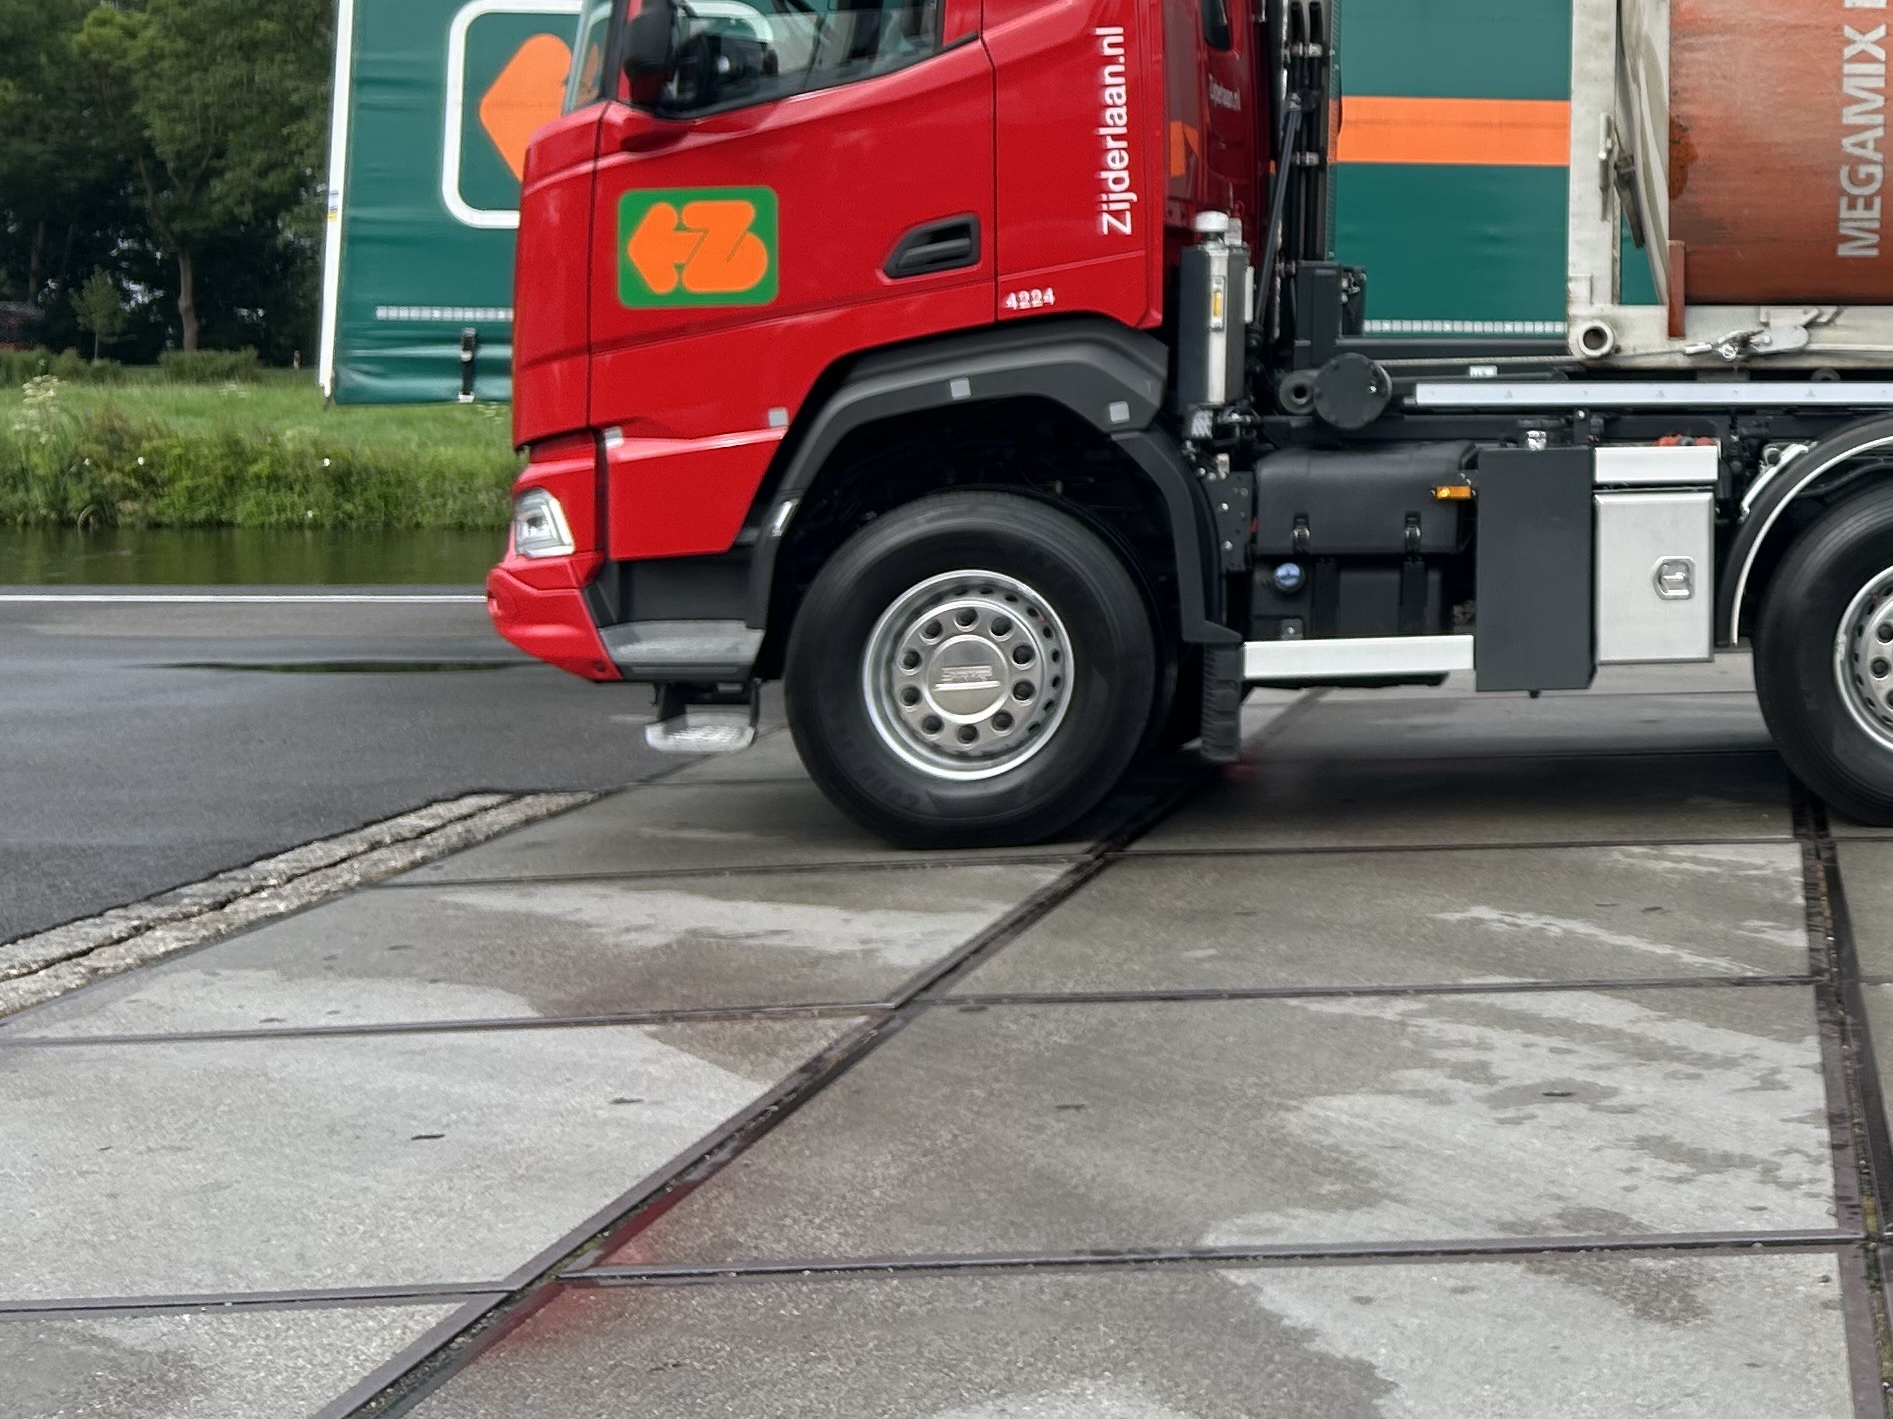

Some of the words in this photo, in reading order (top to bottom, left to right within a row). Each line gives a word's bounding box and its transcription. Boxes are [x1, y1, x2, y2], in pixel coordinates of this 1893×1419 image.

[1095, 26, 1137, 236] Zijderlaan.nl
[1837, 23, 1887, 257] MEGAMIX
[1004, 287, 1055, 311] 4224
